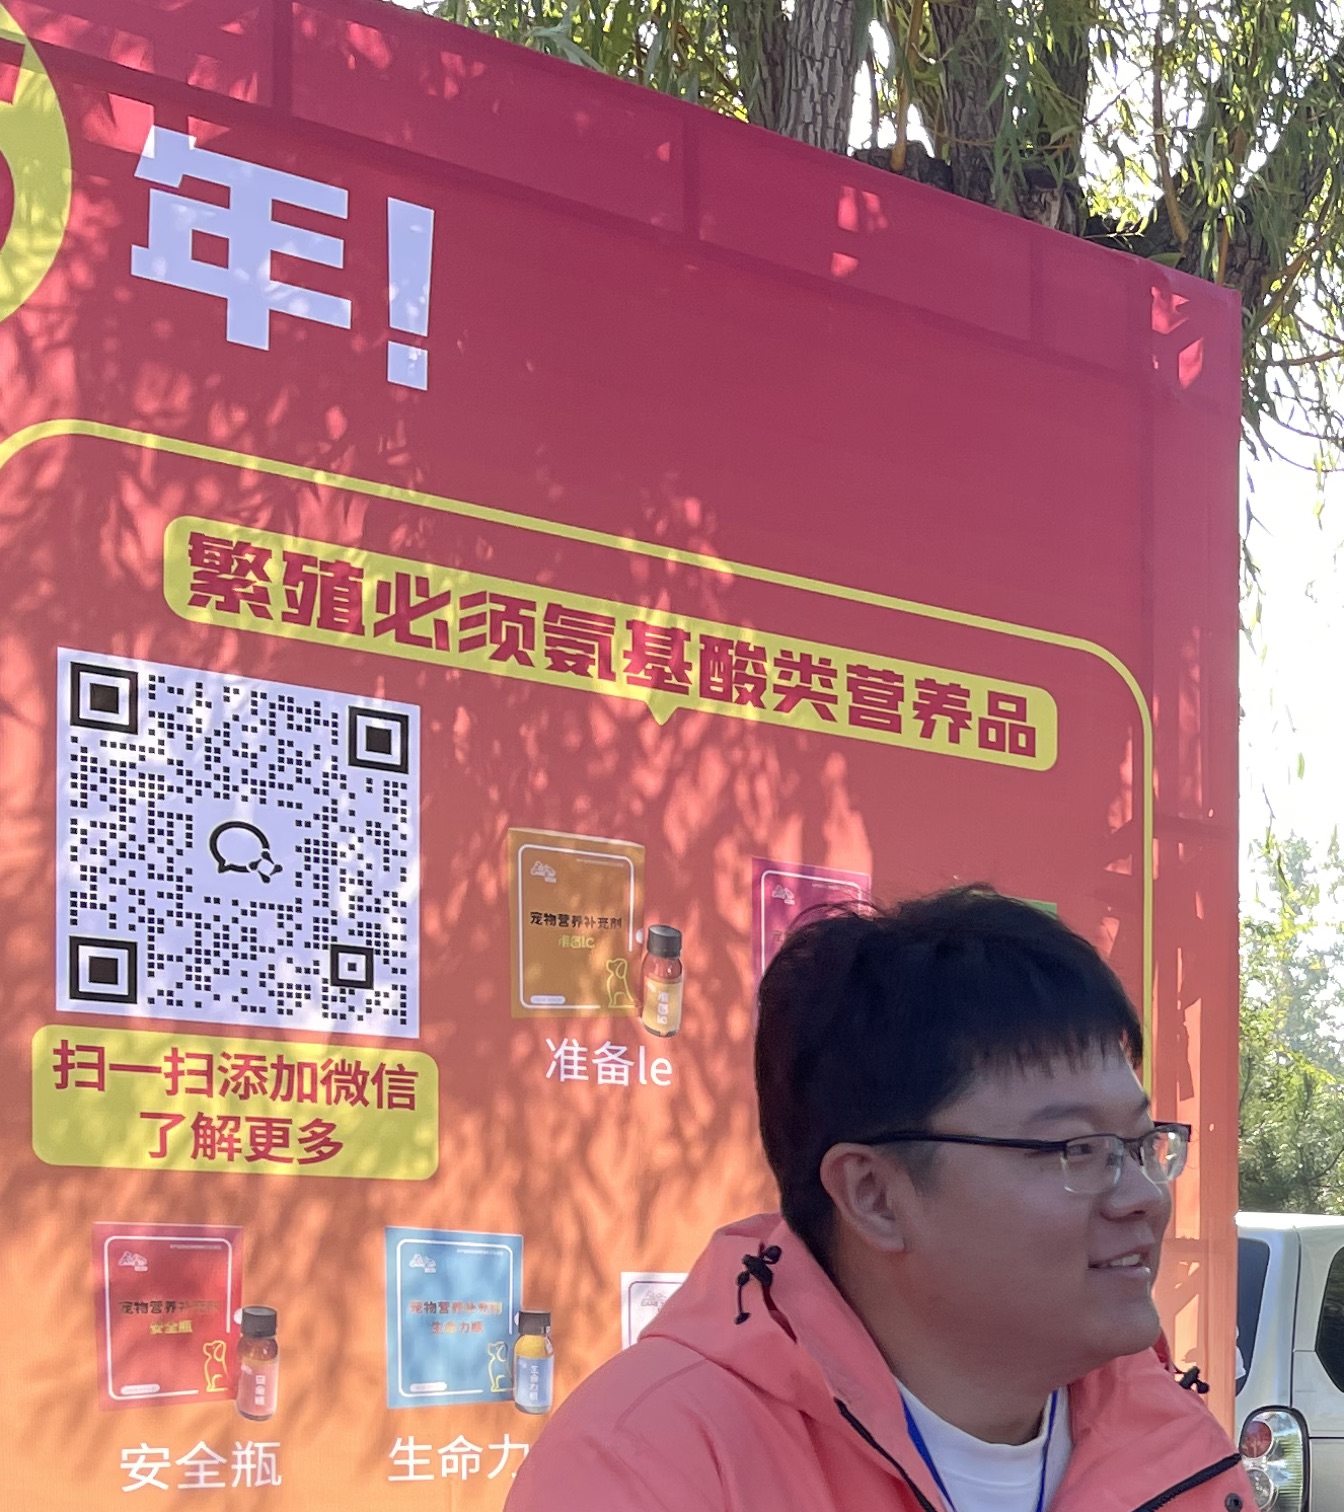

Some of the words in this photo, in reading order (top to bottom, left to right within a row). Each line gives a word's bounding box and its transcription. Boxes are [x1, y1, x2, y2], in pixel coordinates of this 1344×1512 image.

[131, 125, 435, 391] 年!
[187, 533, 1037, 759] 繁殖必须氨基酸类营养品
[52, 1038, 420, 1111] 扫一扫添加微信
[545, 1037, 673, 1087] 准备le
[138, 1110, 345, 1166] 了解更多
[118, 1440, 283, 1493] 安全瓶
[387, 1432, 530, 1482] 生命力
